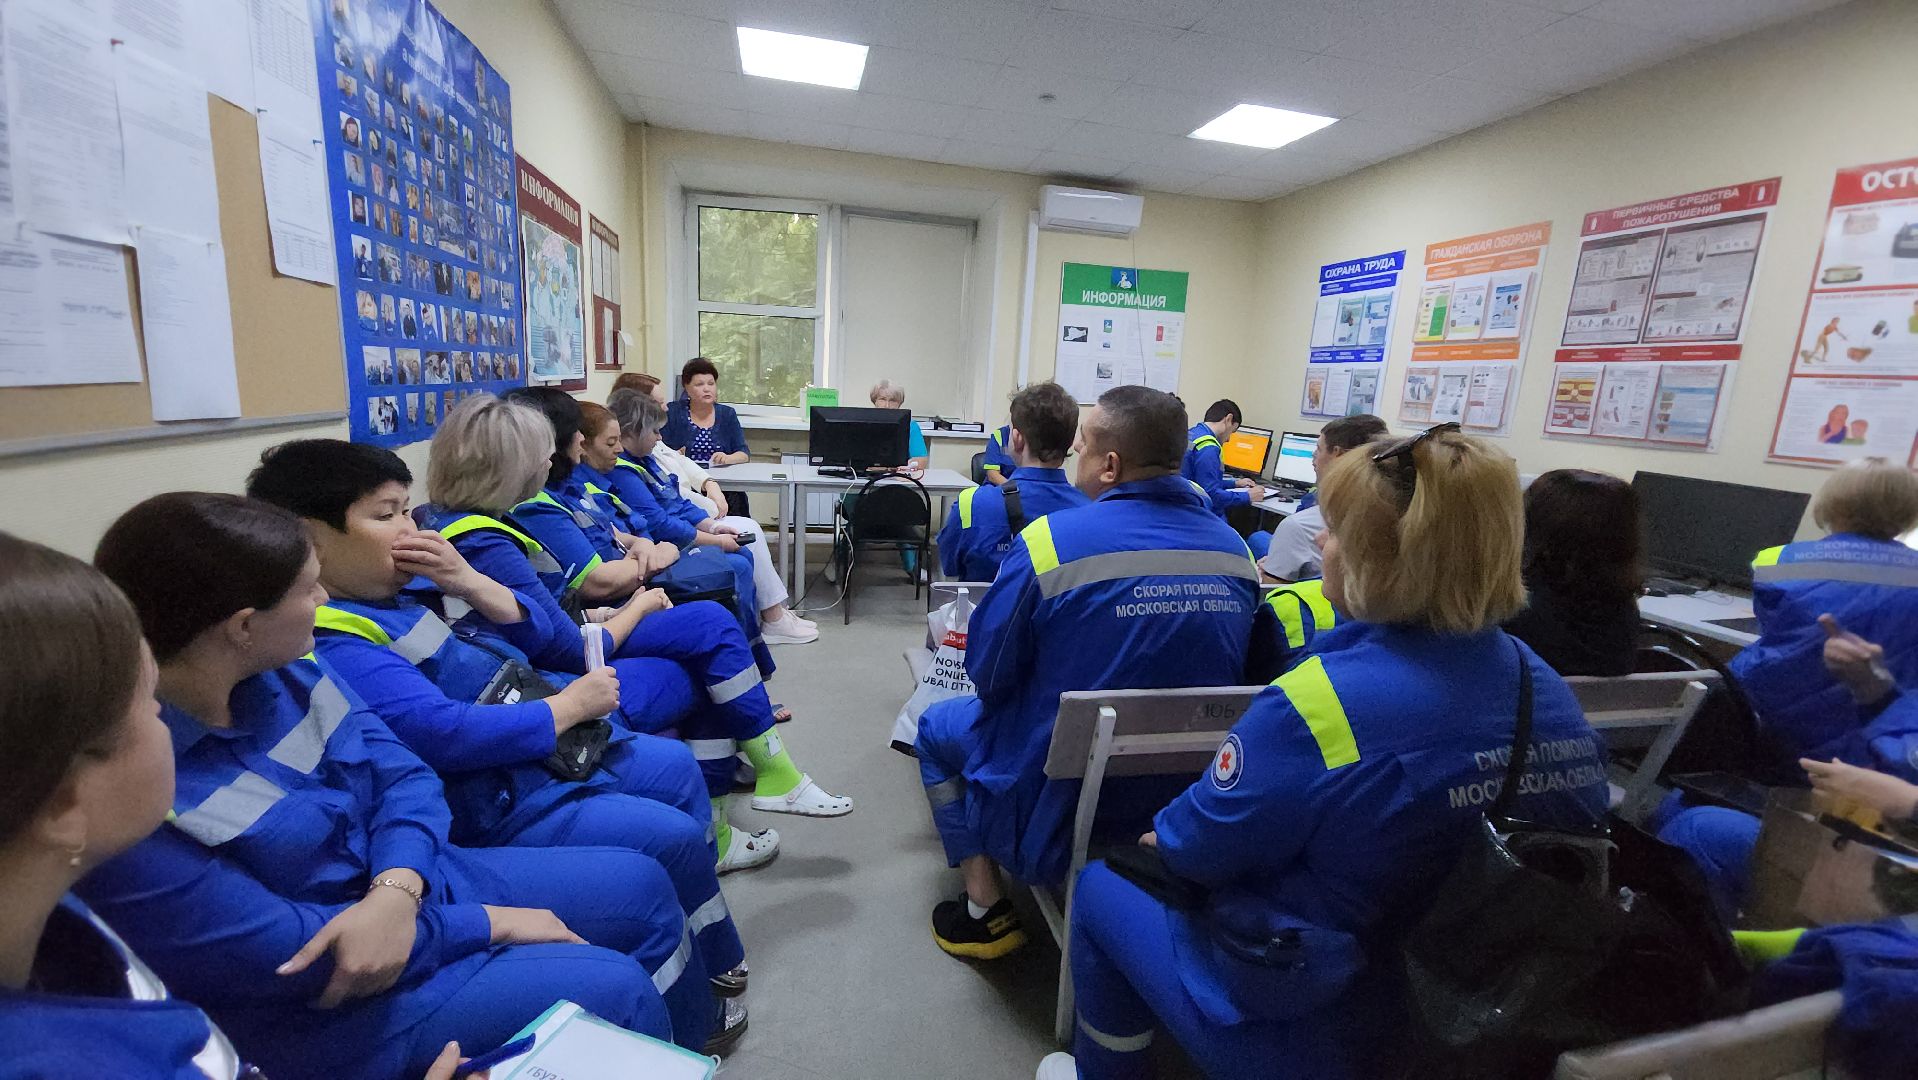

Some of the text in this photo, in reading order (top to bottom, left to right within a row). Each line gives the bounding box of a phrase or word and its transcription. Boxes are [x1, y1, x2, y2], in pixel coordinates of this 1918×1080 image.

[521, 168, 579, 228] ИНФОРМАЦИЯ
[1612, 187, 1740, 219] ПЕРВИЧНЫЕ СРЕДСТВА
[1622, 203, 1722, 229] ПОЖАРОТУШЕНИЯ
[1431, 230, 1543, 260] ГРАЖДАНСКАЯ ОБОРОНА
[1324, 257, 1396, 279] ОХРАНА ТРУДА
[1082, 290, 1166, 308] ИНФОРМАЦИЯ
[996, 543, 1011, 552] МО
[1815, 540, 1870, 552] СКОРАЯ
[1794, 550, 1888, 563] МОСКОВСКАЯ
[1133, 583, 1231, 599] СКОРАЯ ПОМОЩЬ
[1115, 599, 1242, 618] МОСКОВСКАЯ ОБЛАСТЬ
